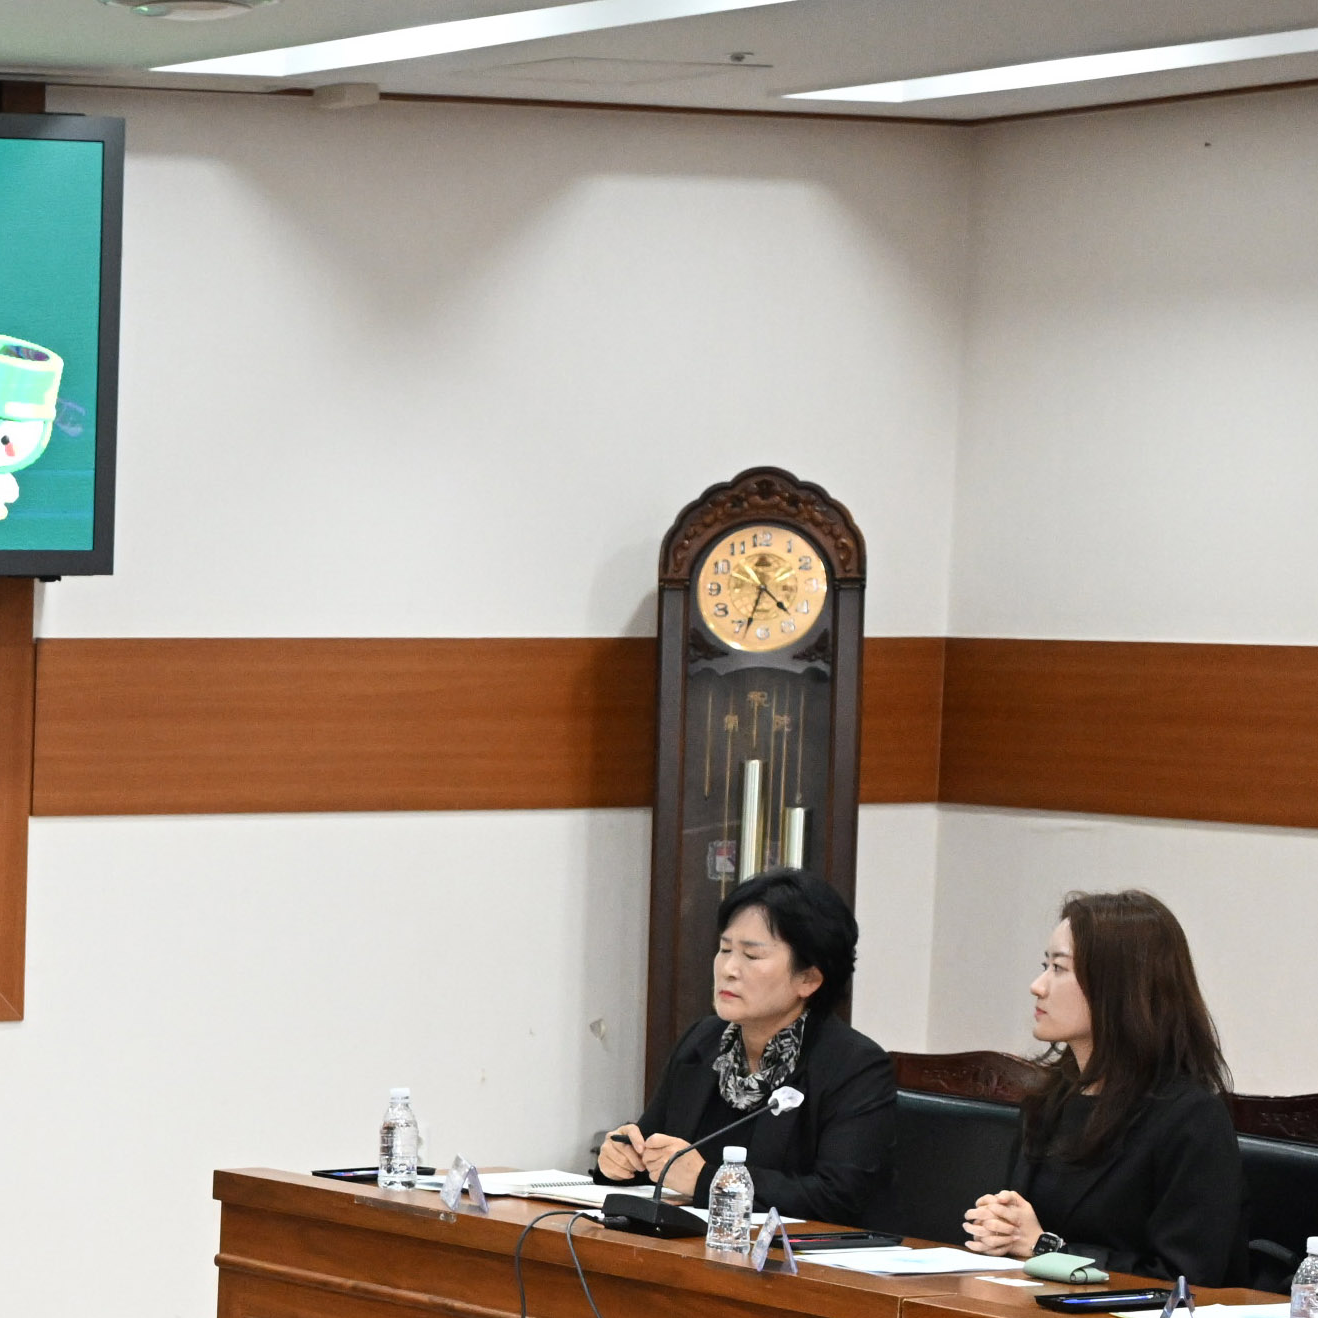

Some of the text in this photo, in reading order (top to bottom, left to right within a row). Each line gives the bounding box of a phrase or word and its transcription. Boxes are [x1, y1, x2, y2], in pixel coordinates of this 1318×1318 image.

[752, 532, 772, 547] 12
[787, 540, 793, 553] 1
[730, 541, 745, 556] 11
[714, 560, 731, 575] 10
[798, 556, 812, 570] 2
[708, 582, 722, 596] 9
[714, 602, 729, 617] 8
[732, 619, 745, 633] 7
